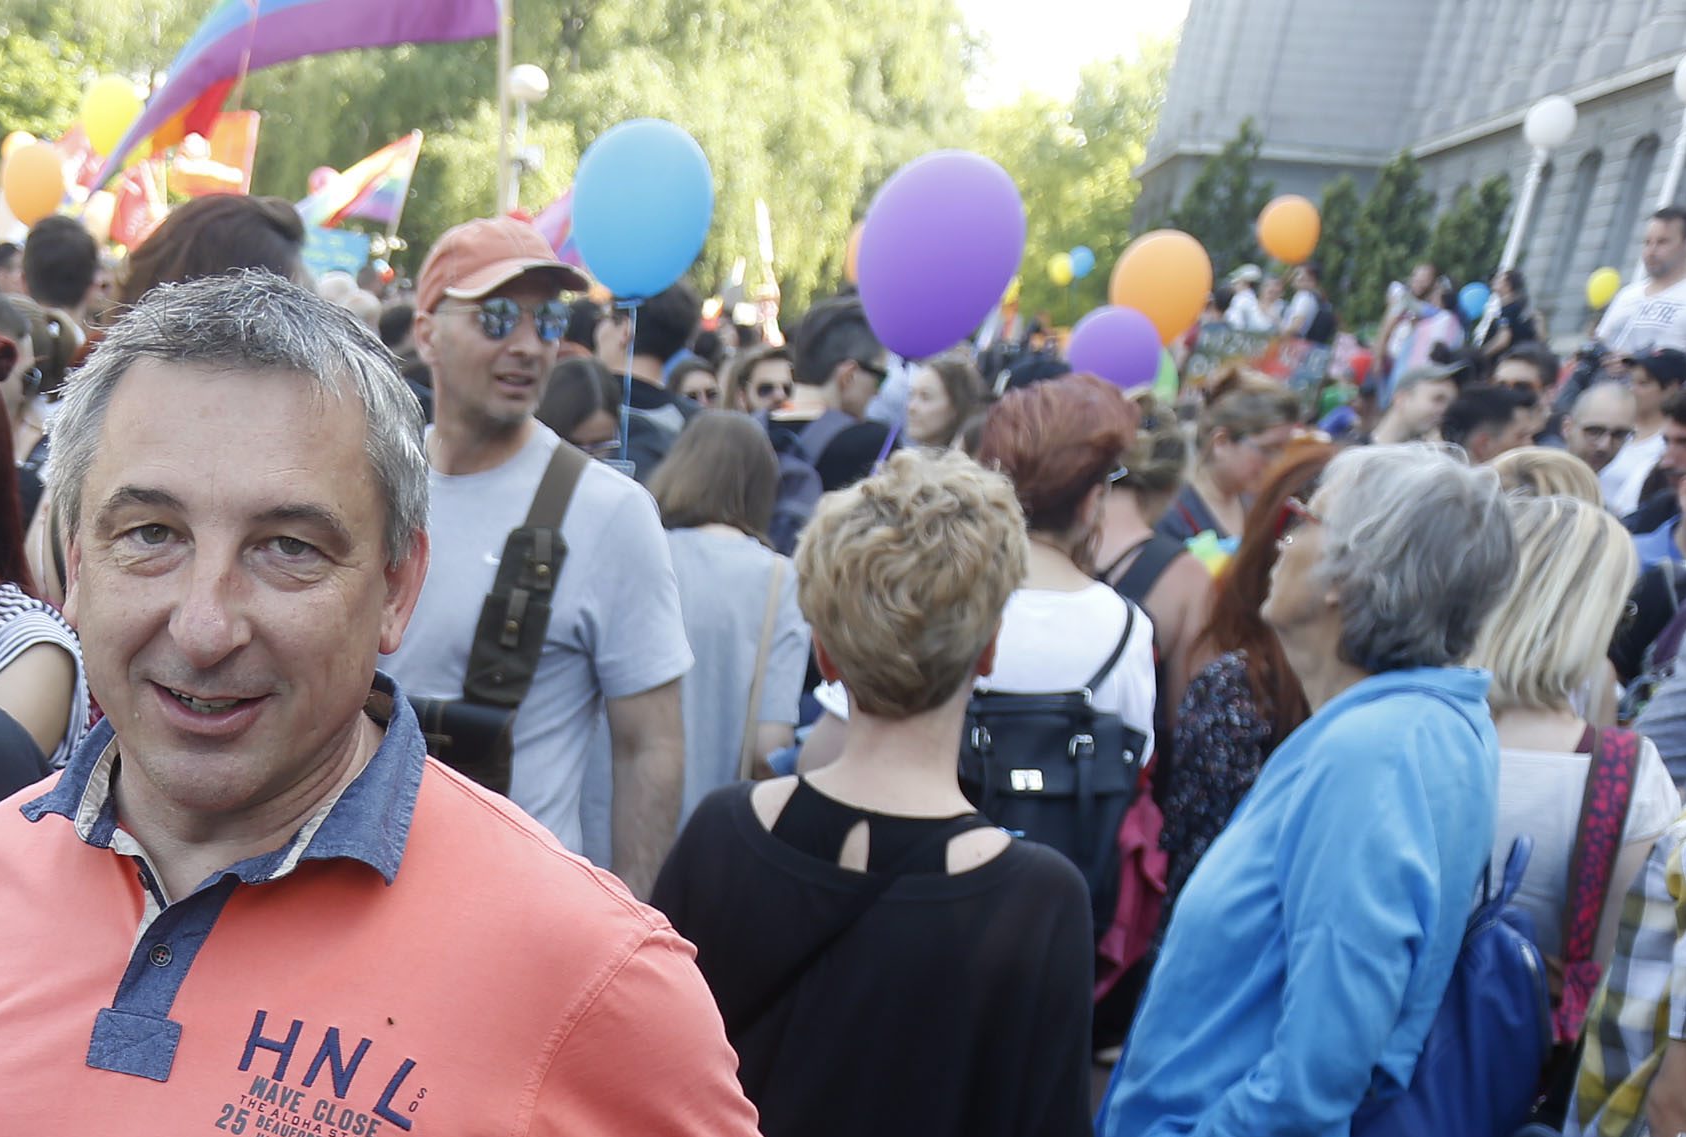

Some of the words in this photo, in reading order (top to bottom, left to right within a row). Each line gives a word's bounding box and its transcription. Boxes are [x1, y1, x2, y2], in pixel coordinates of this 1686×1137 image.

[238, 1009, 417, 1132] HNL
[240, 1094, 268, 1113] THE
[270, 1108, 322, 1134] ALOHA
[249, 1075, 306, 1114] WAVE
[215, 1103, 250, 1135] 25
